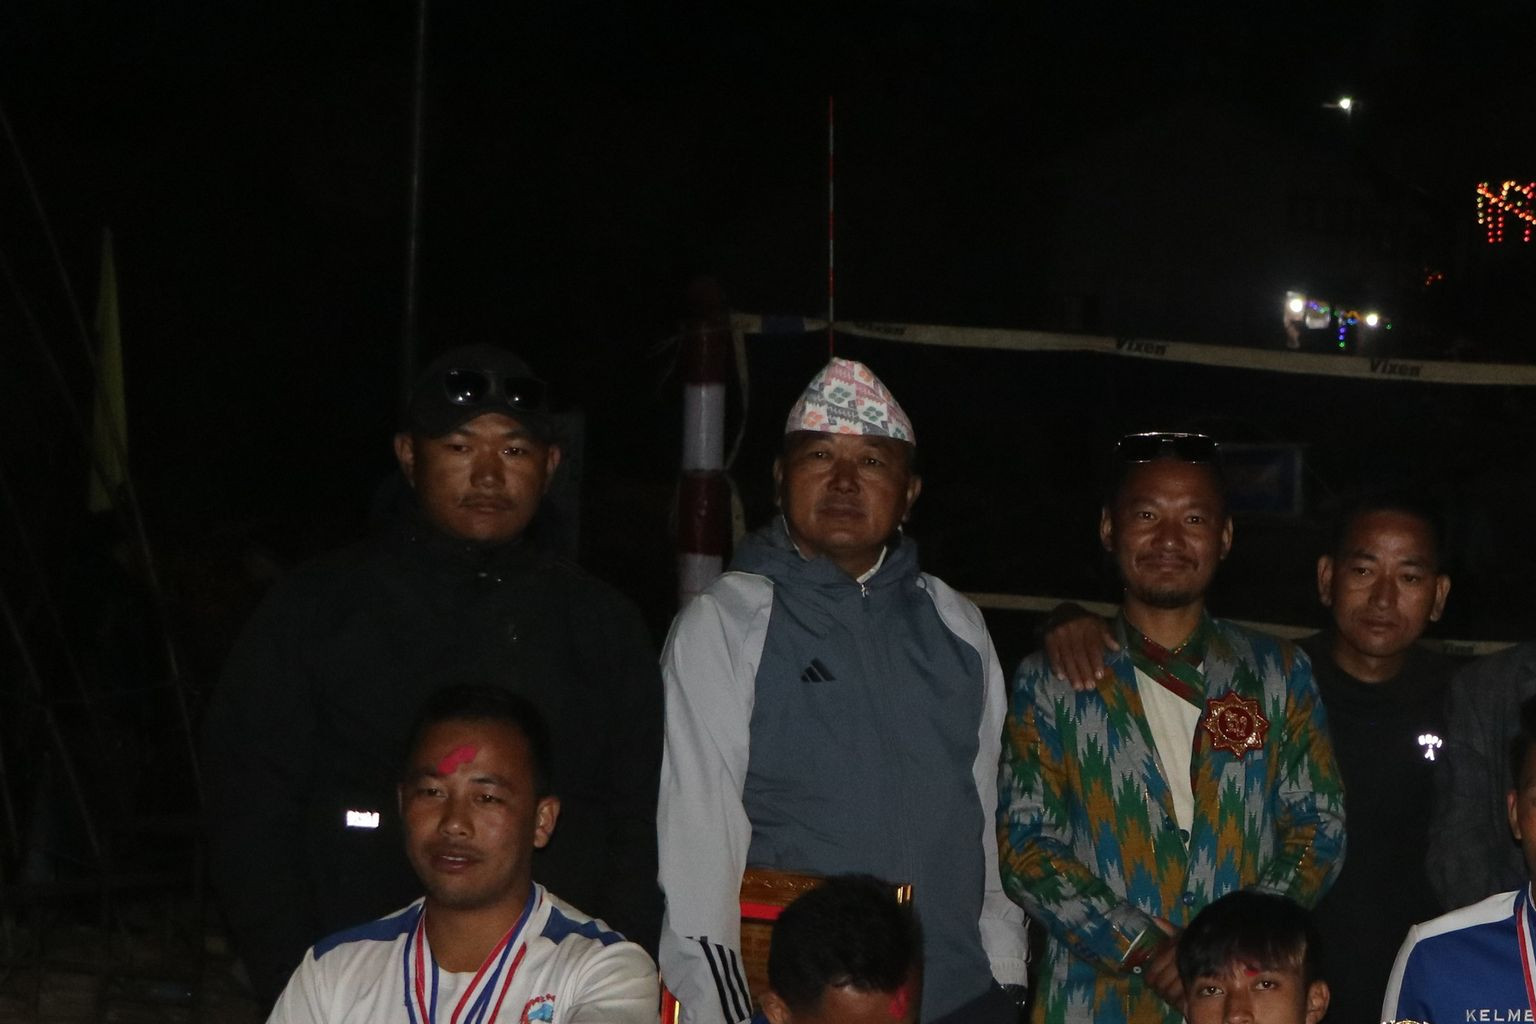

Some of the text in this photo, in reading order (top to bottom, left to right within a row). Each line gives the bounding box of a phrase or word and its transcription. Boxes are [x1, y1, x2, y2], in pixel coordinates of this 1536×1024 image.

[1117, 335, 1168, 356] Vixen
[1370, 359, 1422, 377] Vixen
[1466, 1009, 1535, 1023] KELME
